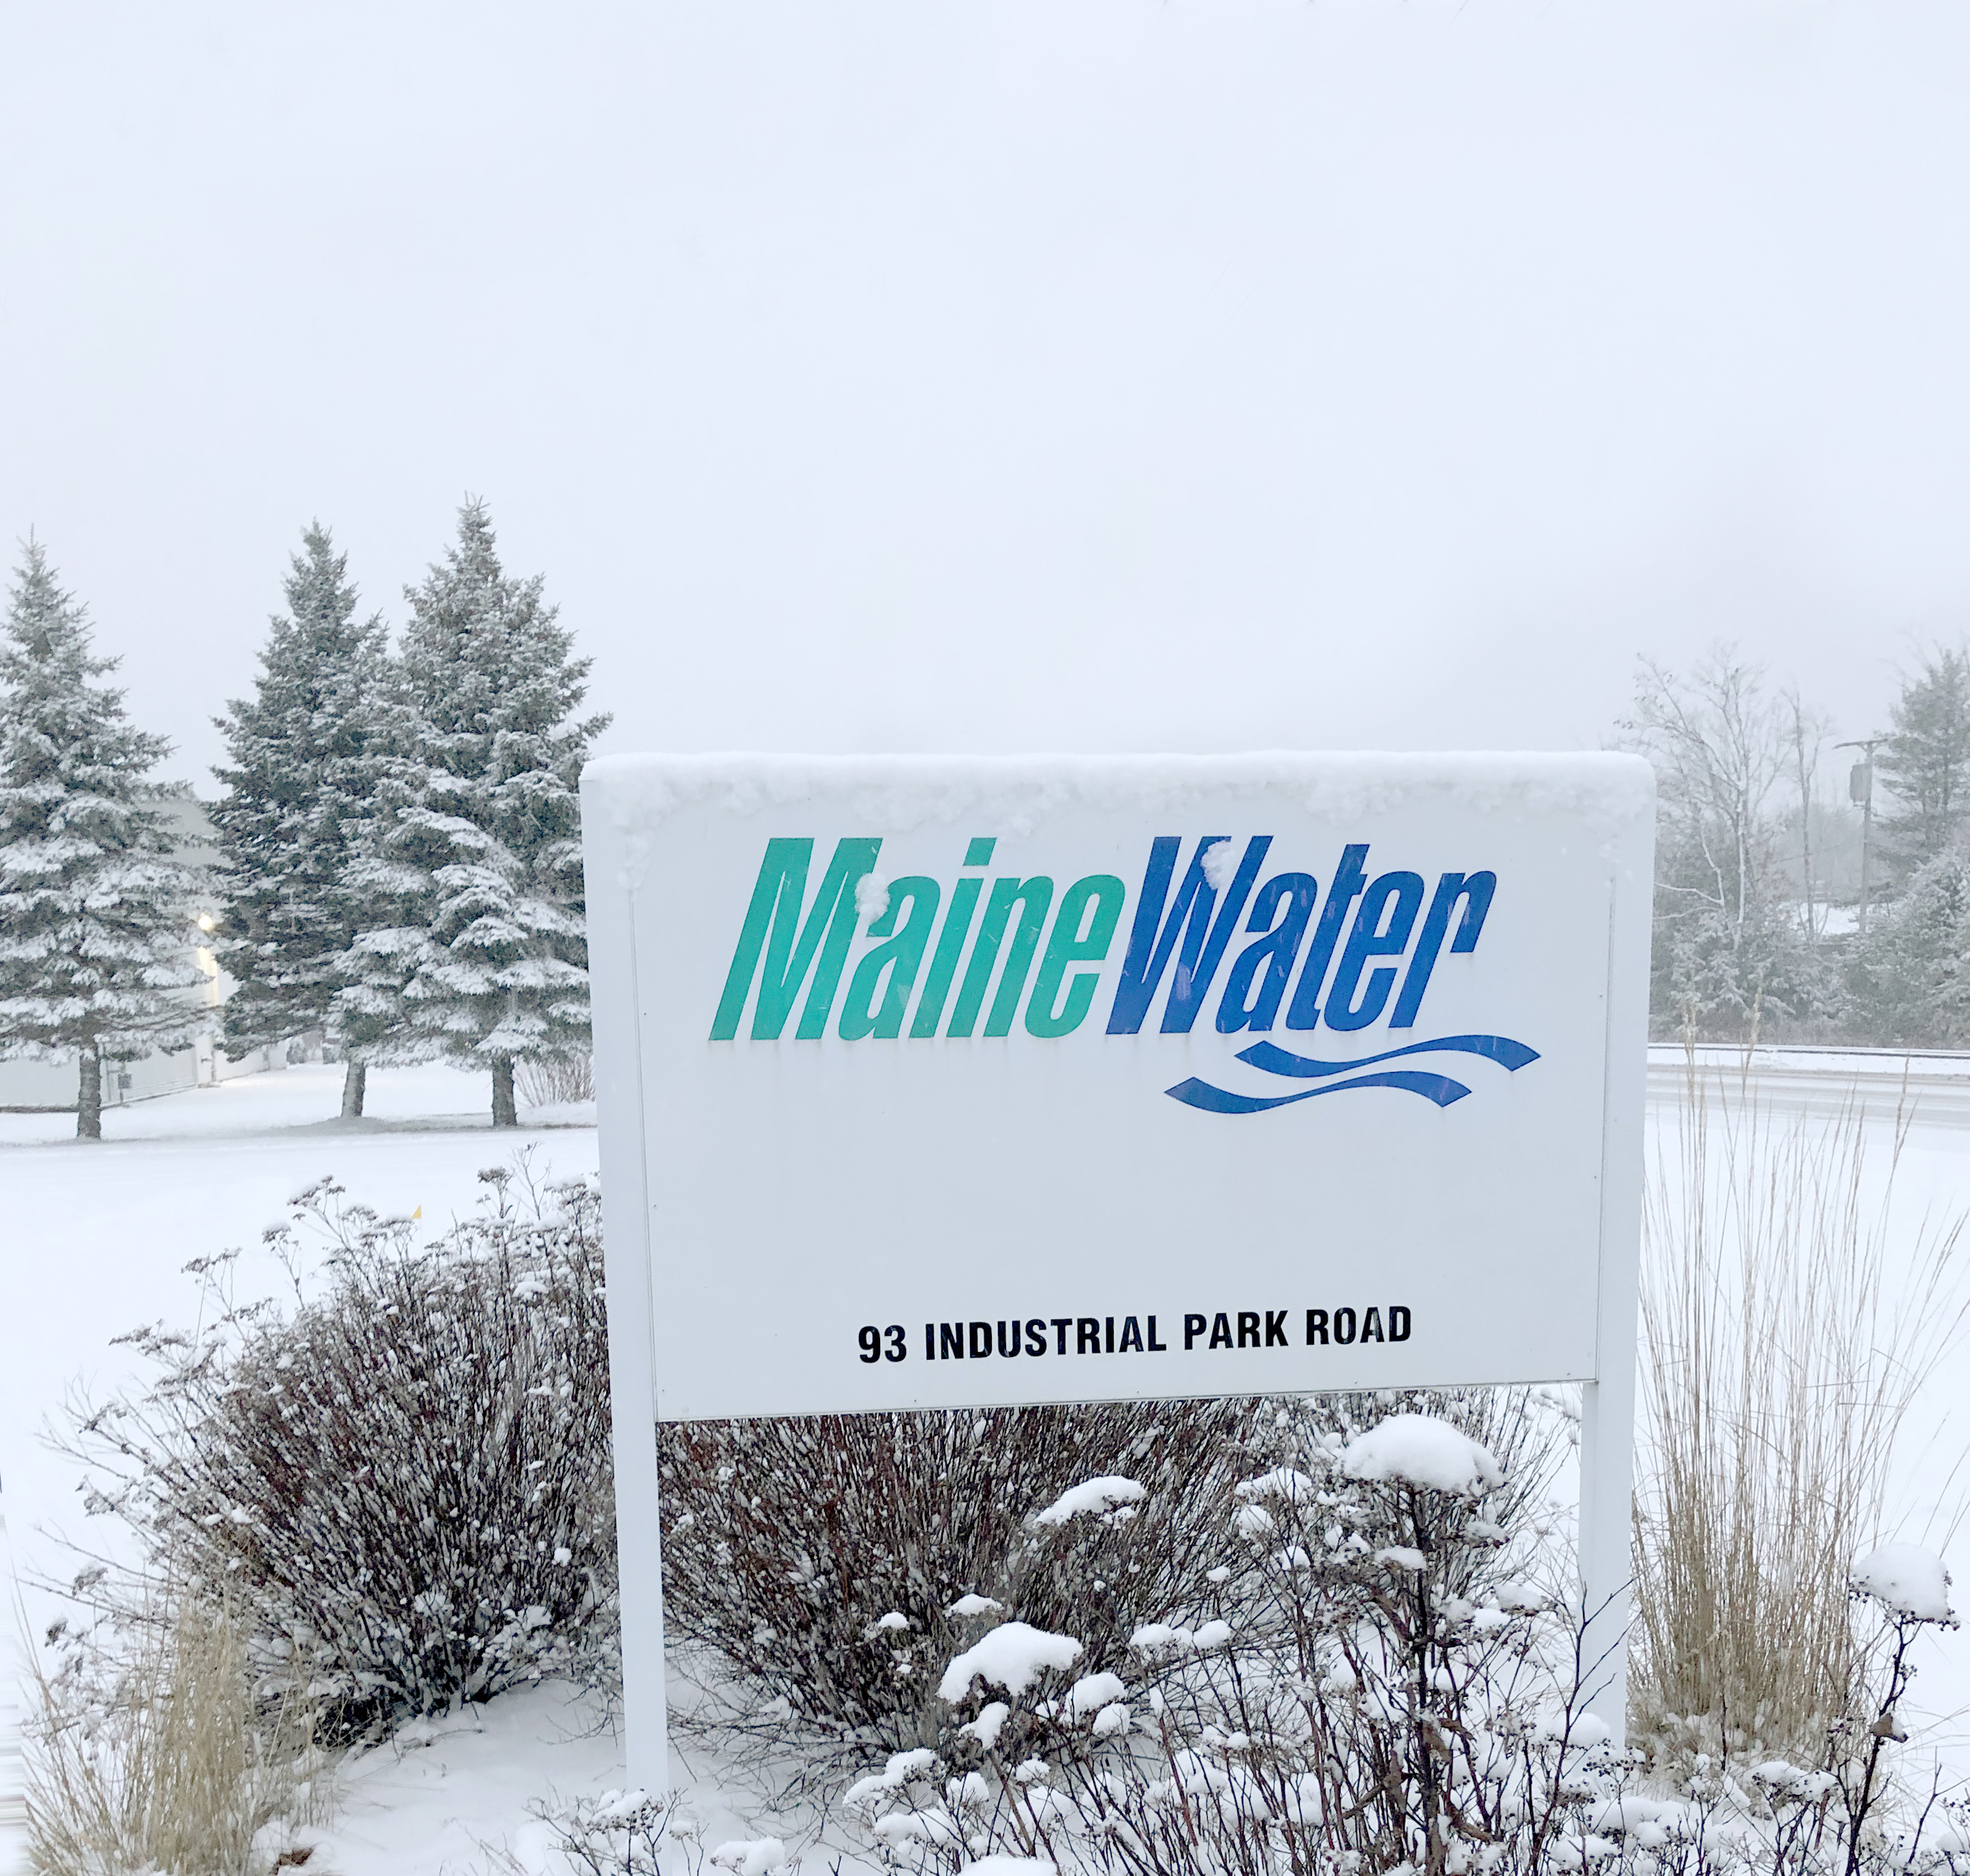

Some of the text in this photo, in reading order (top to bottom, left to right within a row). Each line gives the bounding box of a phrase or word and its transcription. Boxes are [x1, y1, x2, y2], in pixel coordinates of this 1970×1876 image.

[858, 1306, 1412, 1364] 93 INDUSTRIAL PARK ROAD
